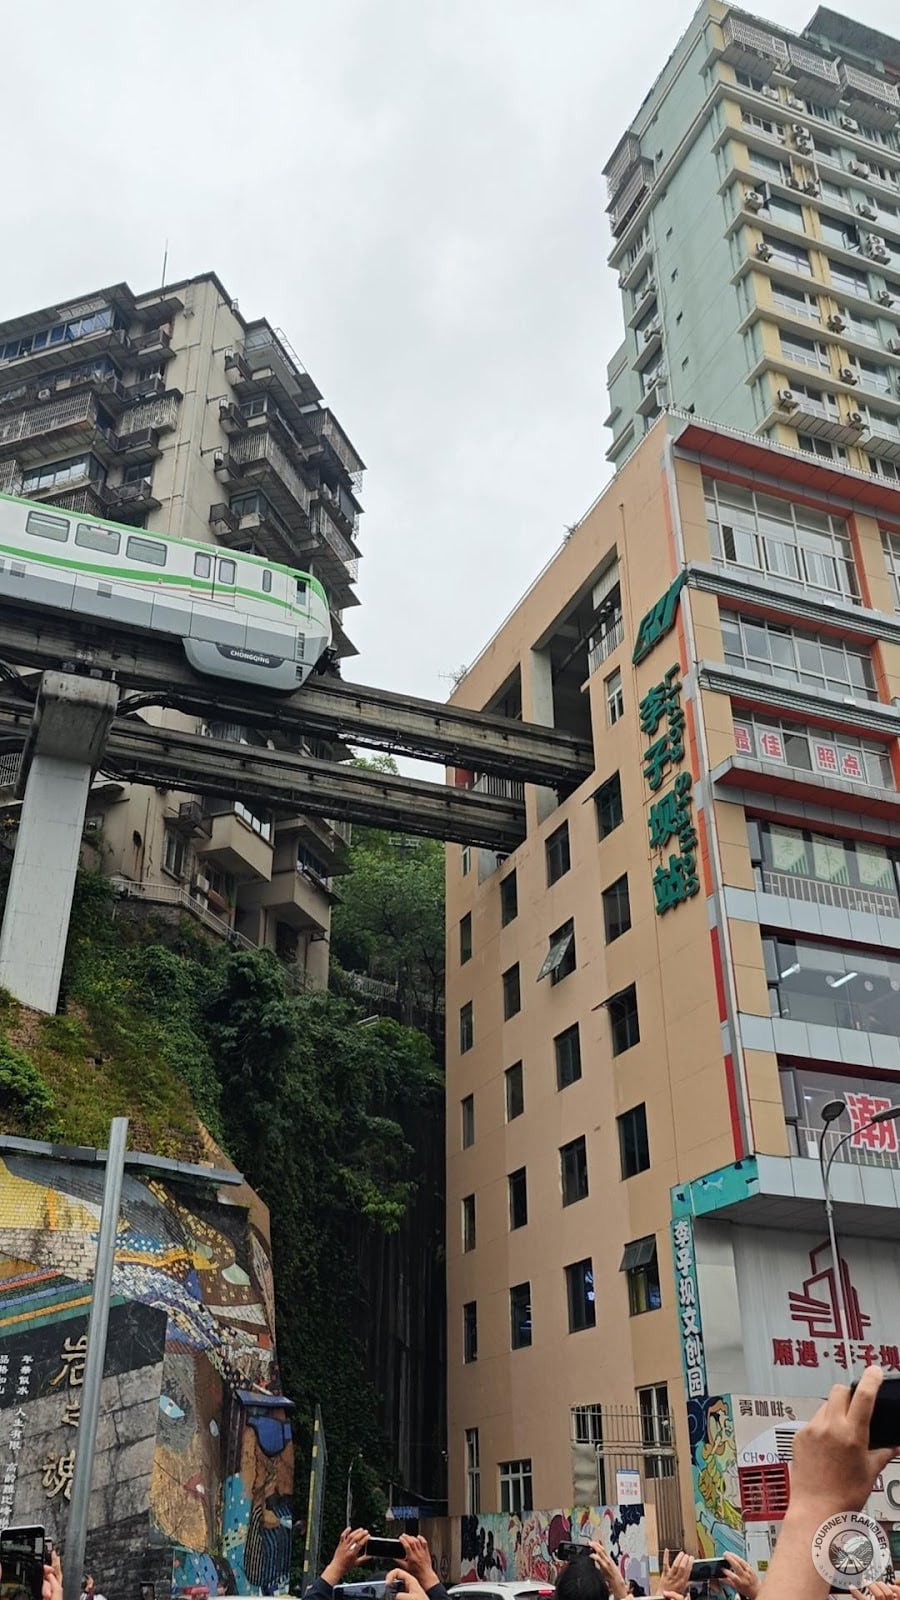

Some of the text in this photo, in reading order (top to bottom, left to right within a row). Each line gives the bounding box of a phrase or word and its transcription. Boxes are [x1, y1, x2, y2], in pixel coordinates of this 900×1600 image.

[230, 650, 270, 664] CHONGQING
[639, 681, 685, 916] 李子坝站
[845, 1093, 898, 1152] 潮
[674, 1220, 706, 1398] 李子坝文创园
